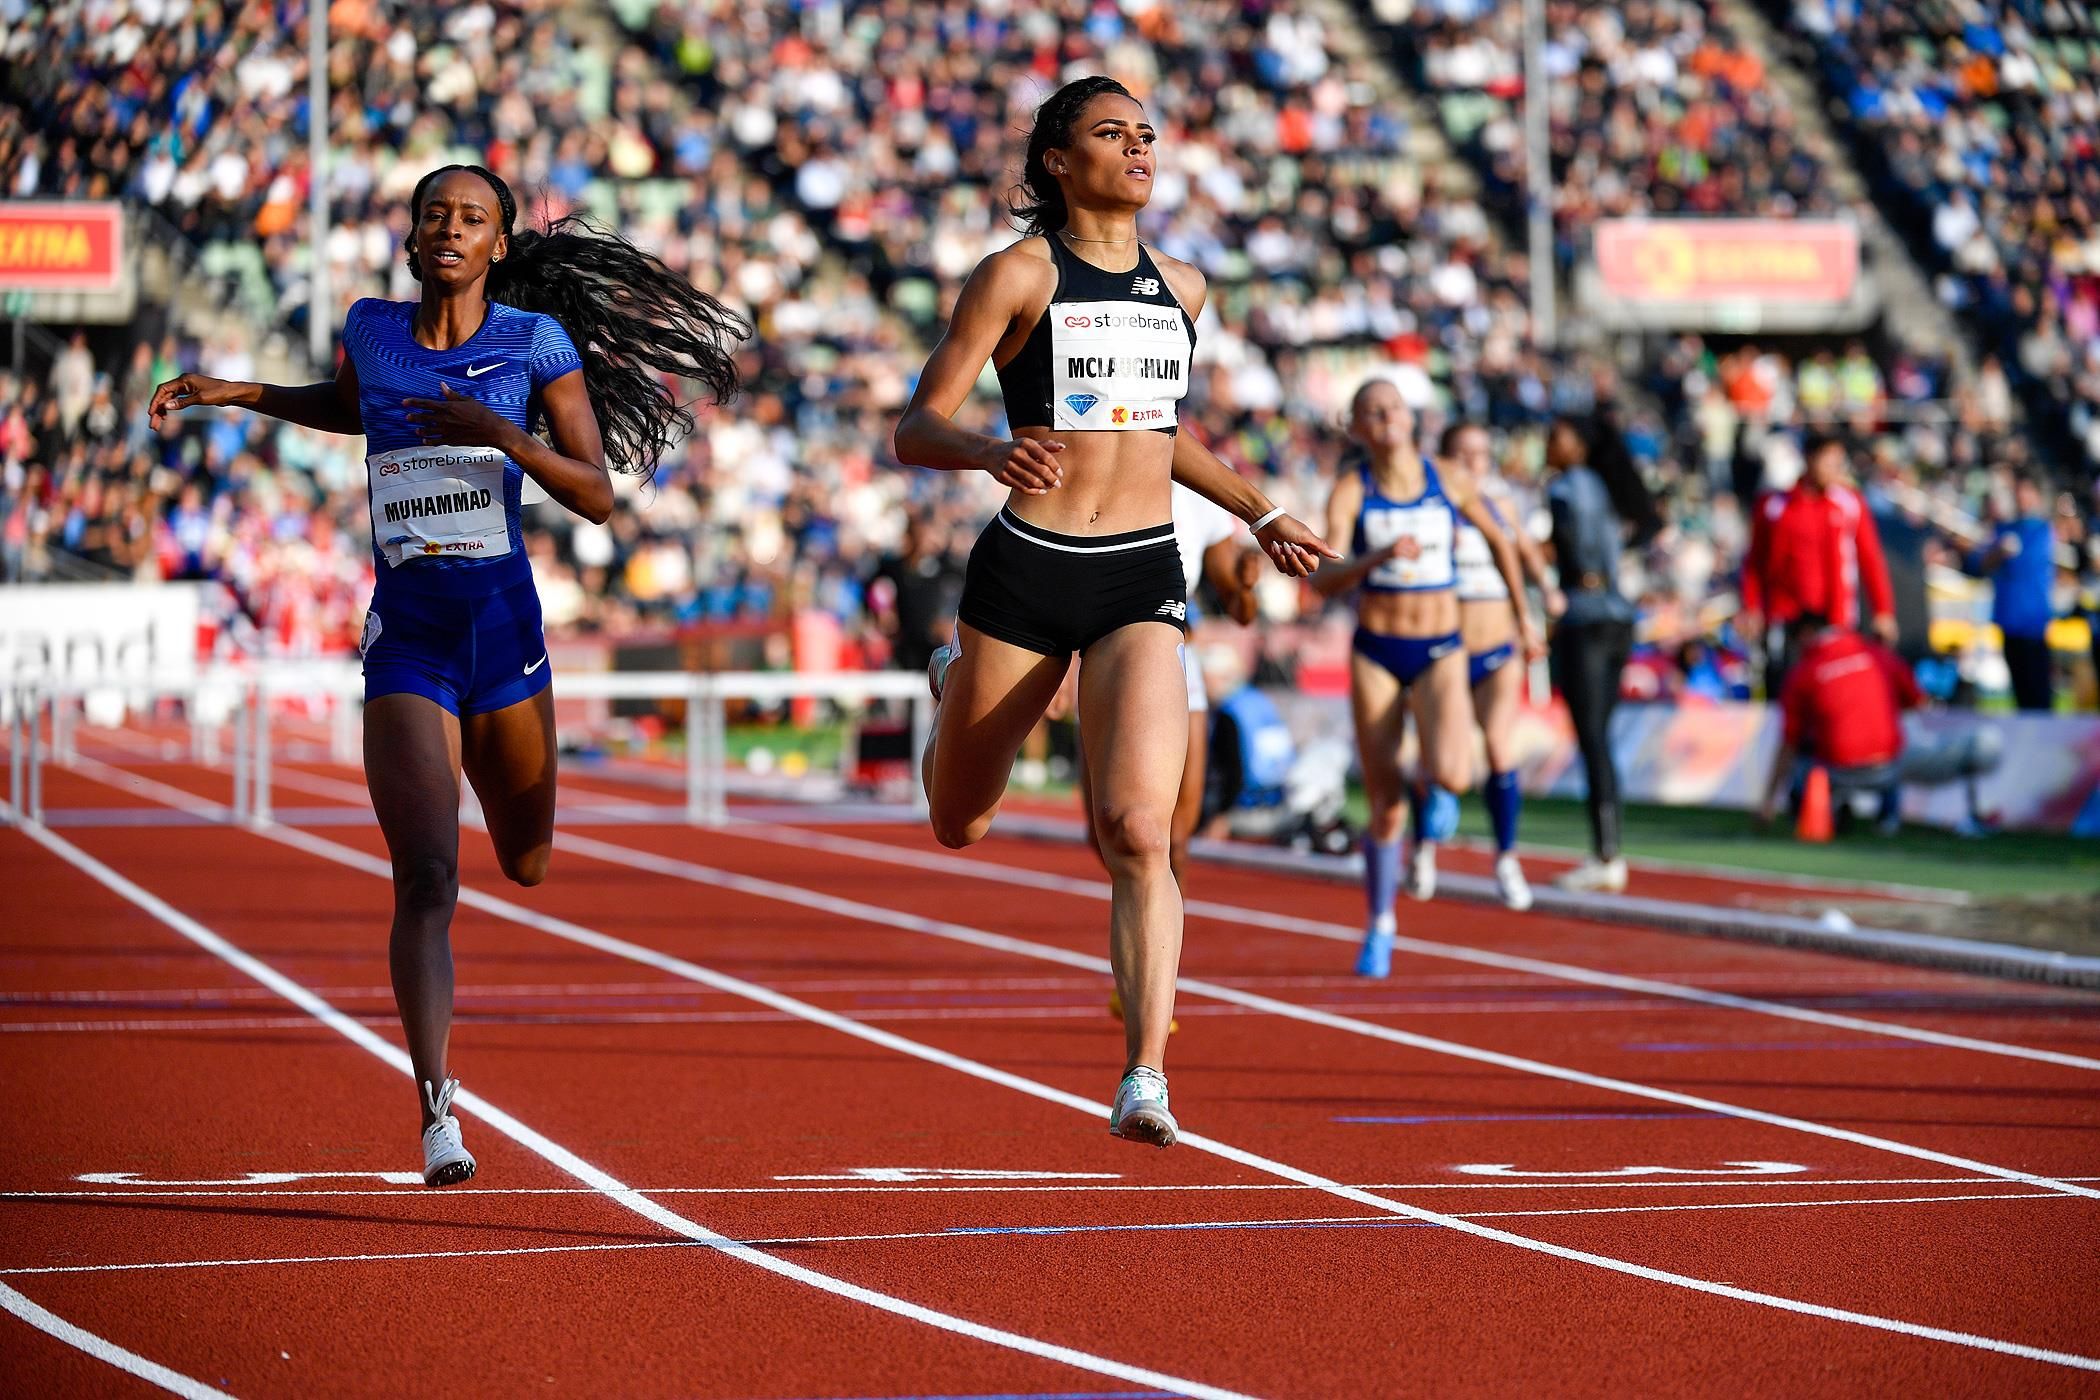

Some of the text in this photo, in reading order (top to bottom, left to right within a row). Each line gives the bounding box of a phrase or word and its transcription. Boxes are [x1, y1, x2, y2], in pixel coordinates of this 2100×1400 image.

[1094, 313, 1178, 331] storebrand
[1068, 357, 1180, 380] MCLAUGHLIN
[1132, 409, 1164, 421] EXTRA
[402, 453, 494, 472] storebrand
[384, 488, 492, 523] MUHAMMAD
[445, 541, 485, 551] EXTRA
[0, 615, 157, 682] and
